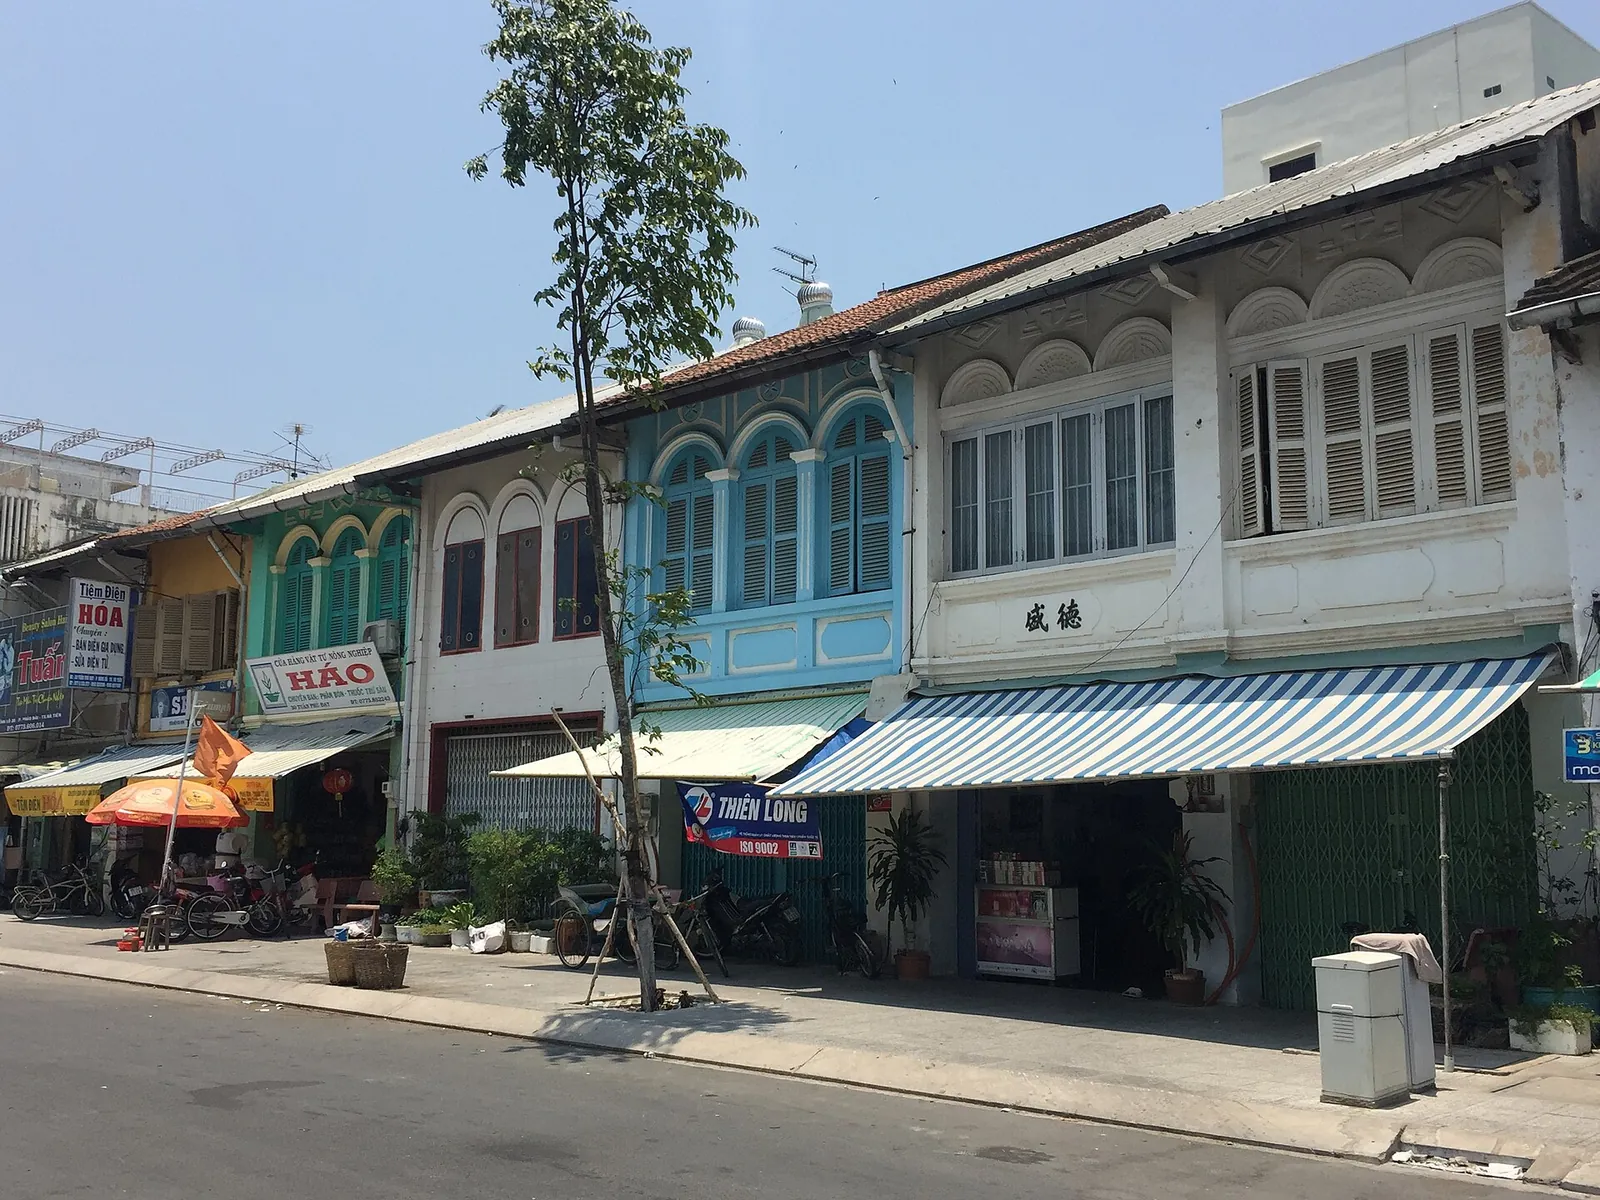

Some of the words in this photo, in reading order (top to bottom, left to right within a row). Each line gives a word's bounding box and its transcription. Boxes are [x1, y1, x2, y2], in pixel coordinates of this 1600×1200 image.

[80, 583, 103, 600] Tiệm
[105, 585, 126, 602] Điện
[78, 601, 123, 627] HÓA
[328, 650, 346, 661] NÔNG
[347, 646, 373, 659] NGHIỆP
[718, 793, 761, 821] THIÊN
[763, 799, 808, 823] LONG
[740, 841, 754, 853] ISO
[755, 842, 779, 855] 9002
